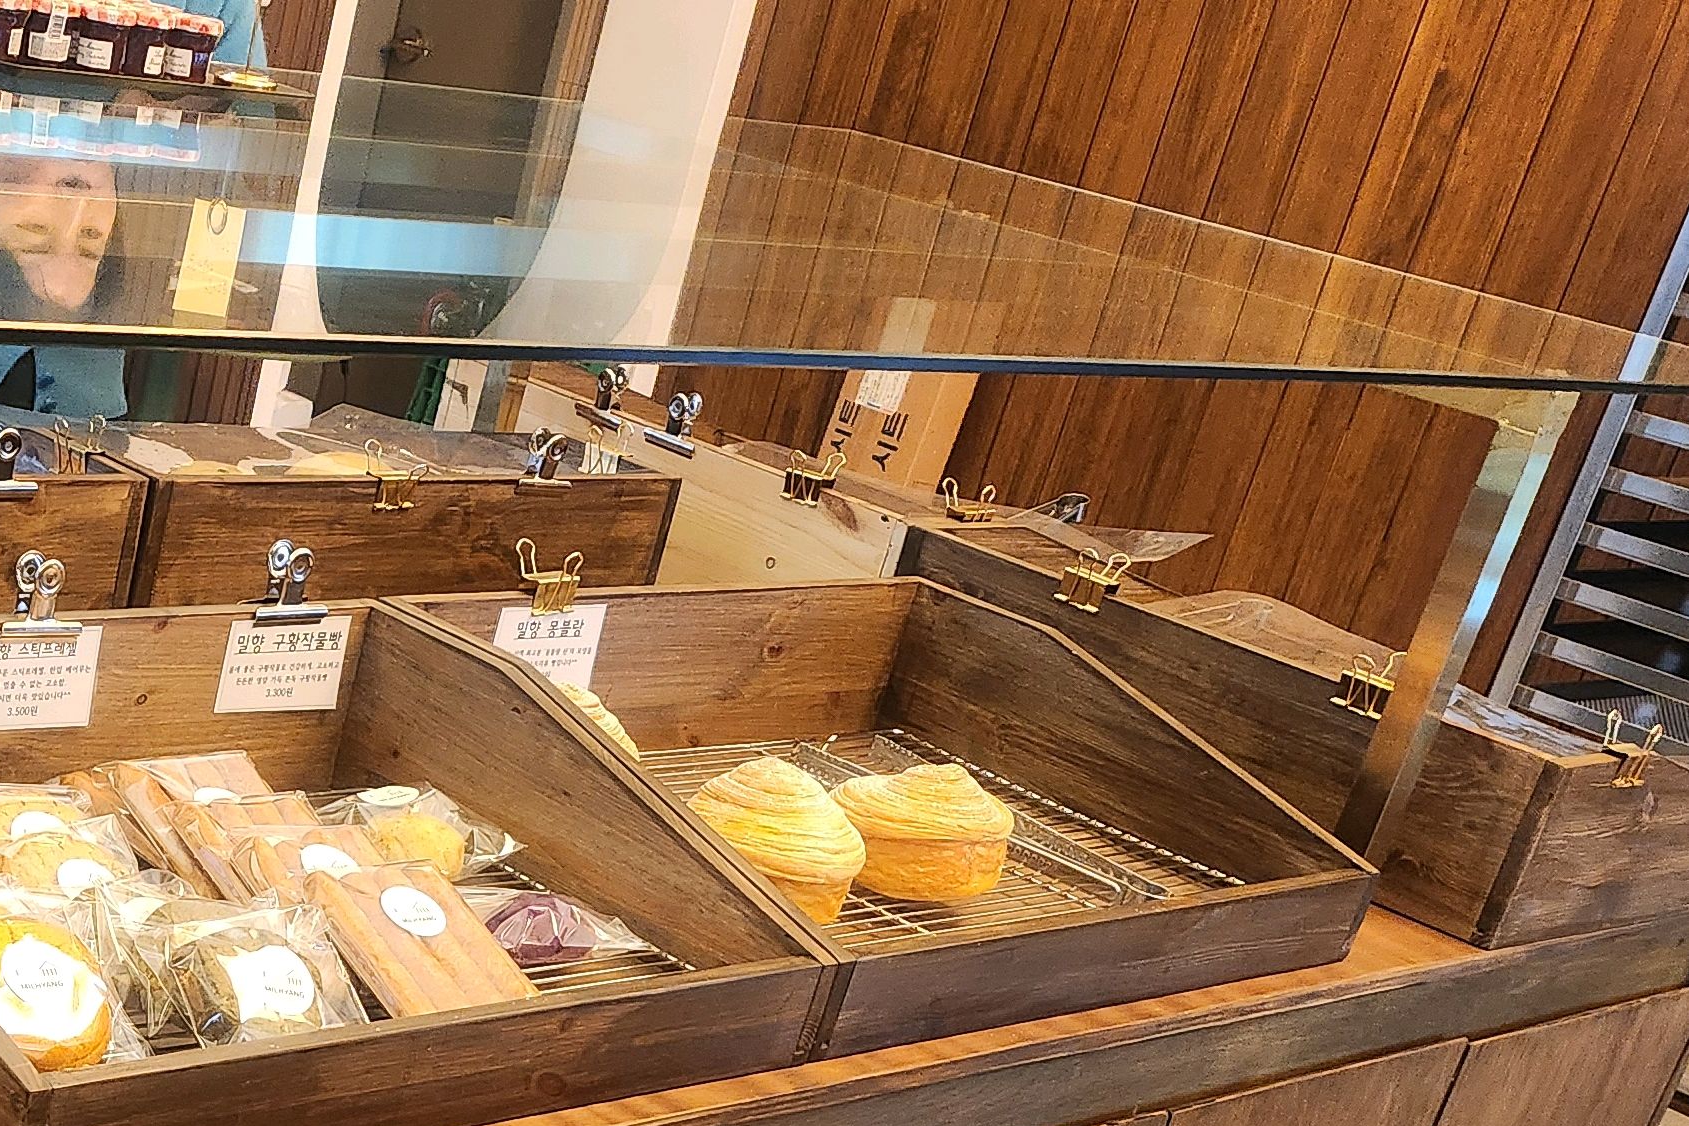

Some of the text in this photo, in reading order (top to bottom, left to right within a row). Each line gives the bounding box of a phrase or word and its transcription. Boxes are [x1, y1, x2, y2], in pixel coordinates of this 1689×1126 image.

[830, 398, 862, 453] 시트
[871, 410, 910, 473] 시트
[236, 630, 343, 654] 밀향 구황작물빵
[517, 618, 585, 639] 밀향 몽블랑
